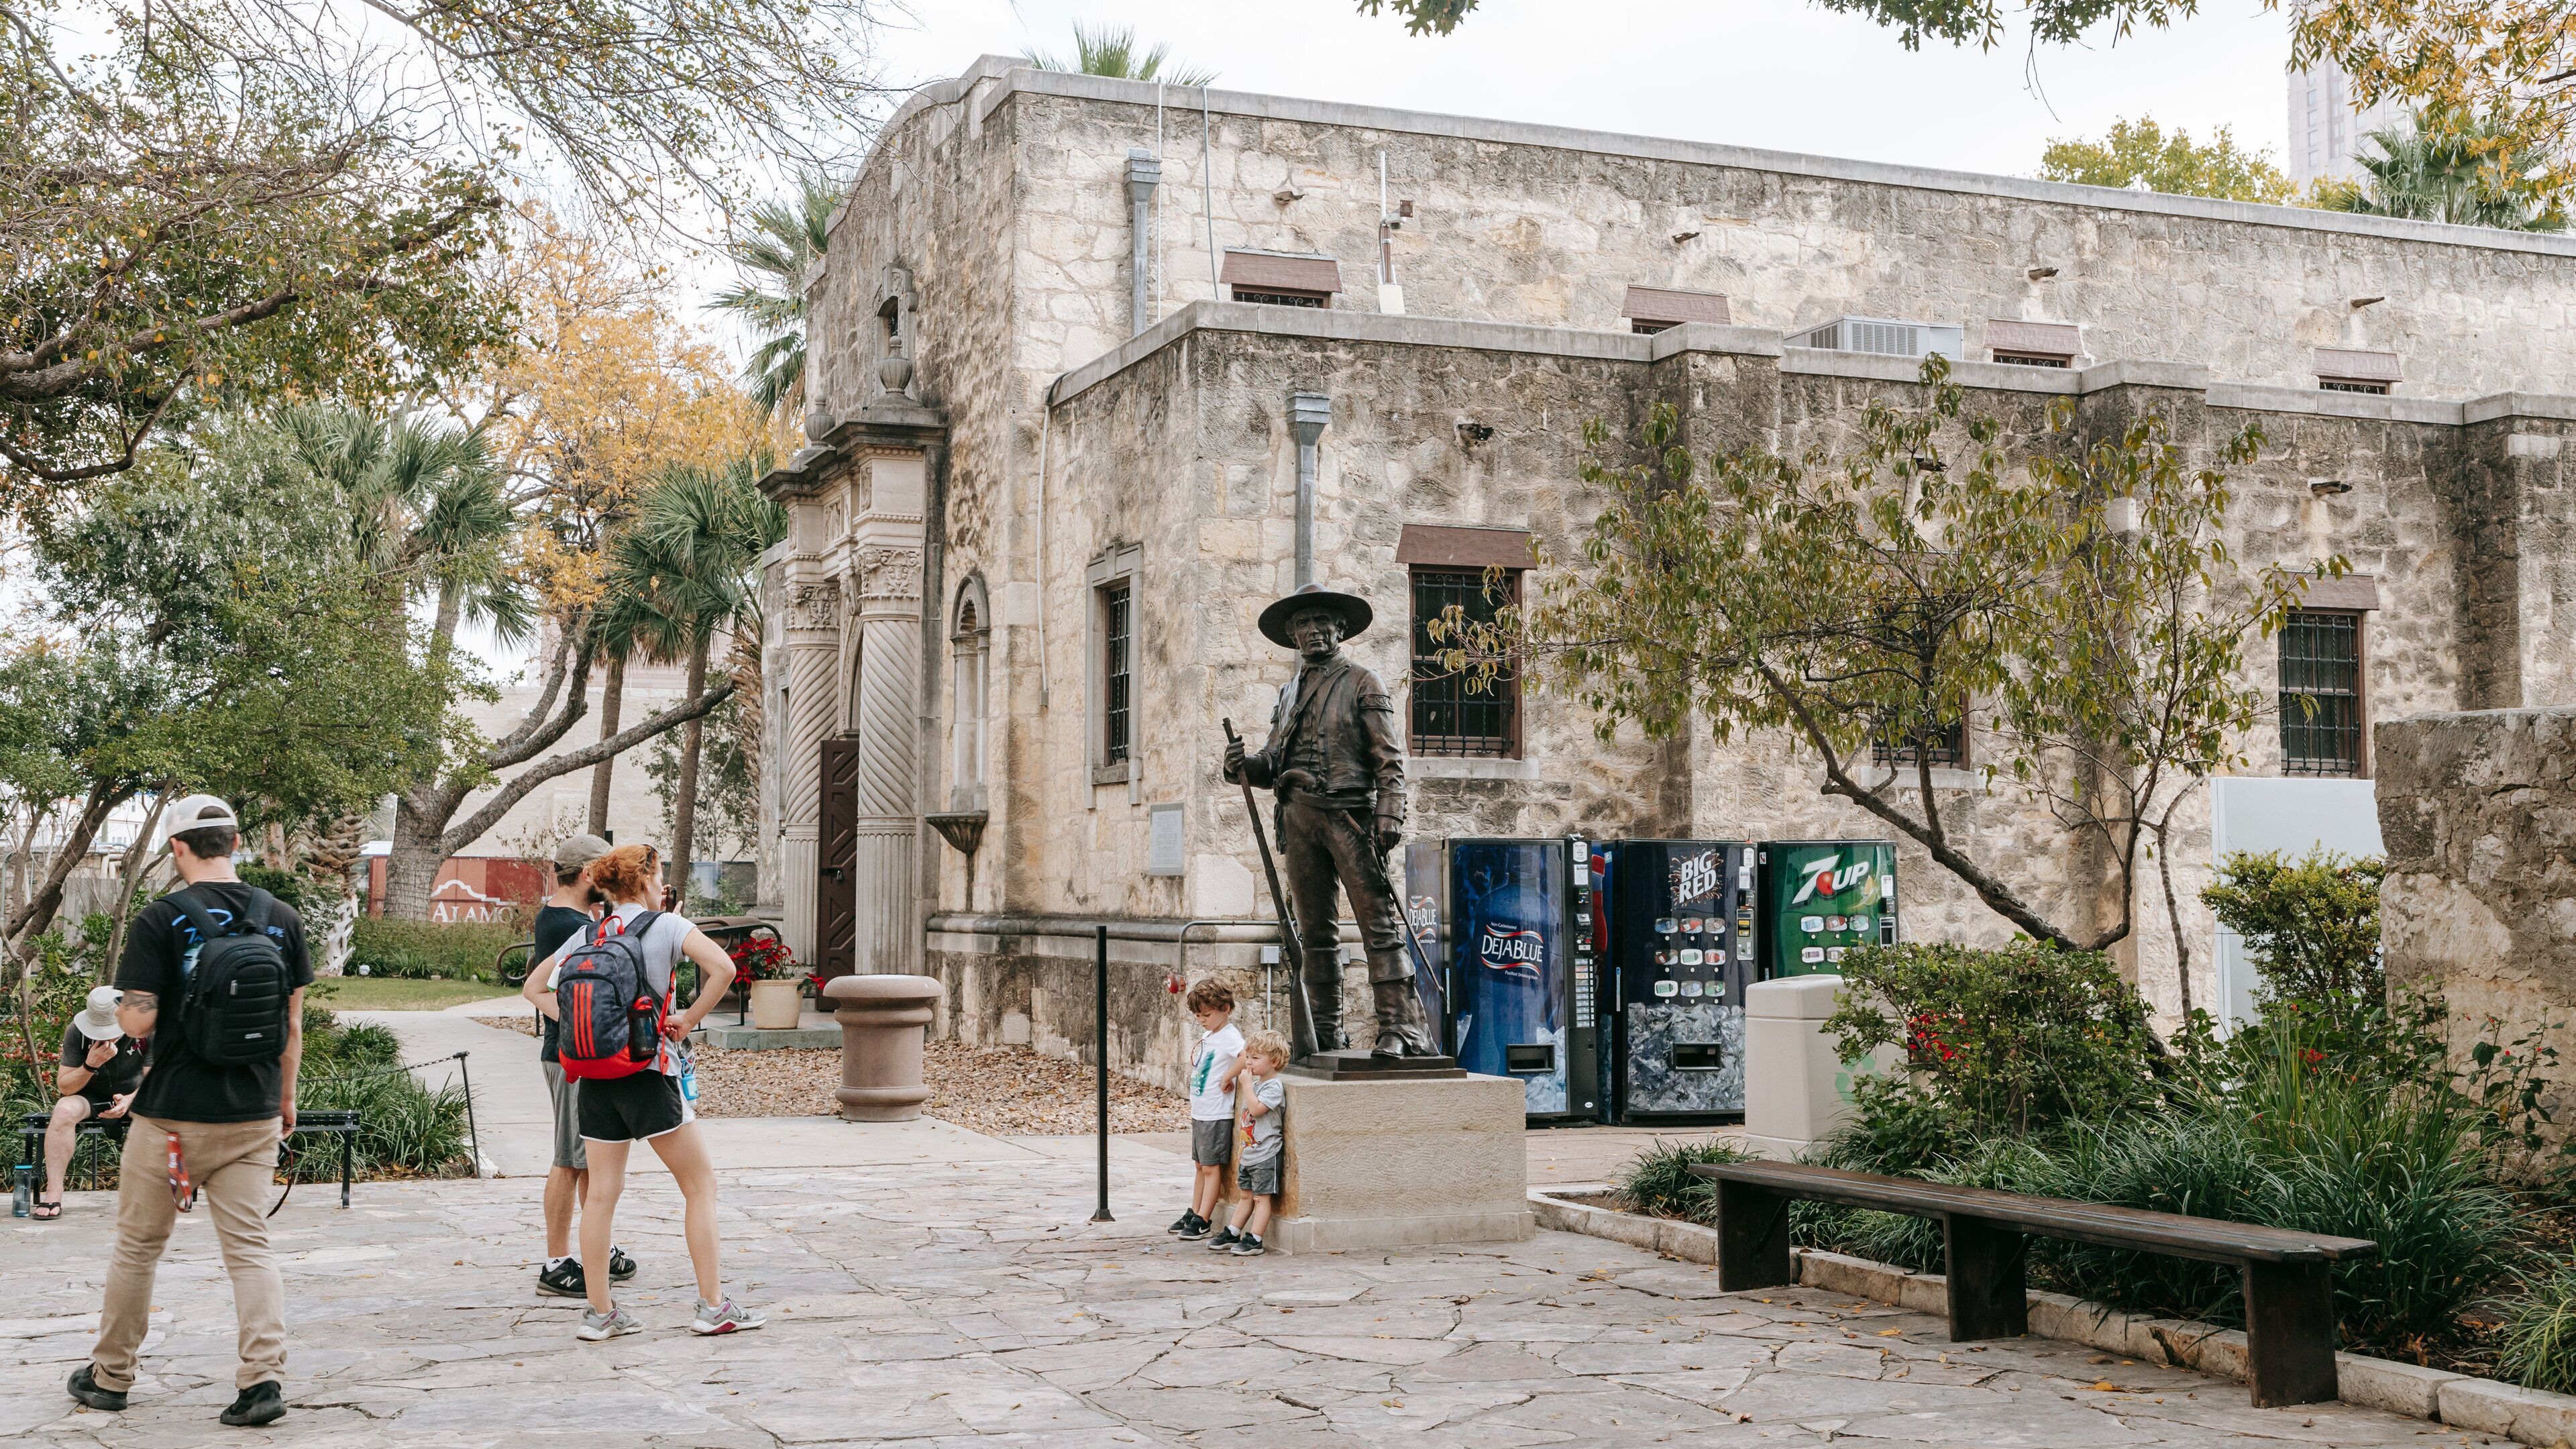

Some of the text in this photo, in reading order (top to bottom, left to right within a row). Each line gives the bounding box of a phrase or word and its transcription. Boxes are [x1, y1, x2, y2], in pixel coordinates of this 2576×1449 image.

[1681, 851, 1712, 883] BIG
[1679, 869, 1717, 904] RED
[429, 901, 515, 924] ALAMO
